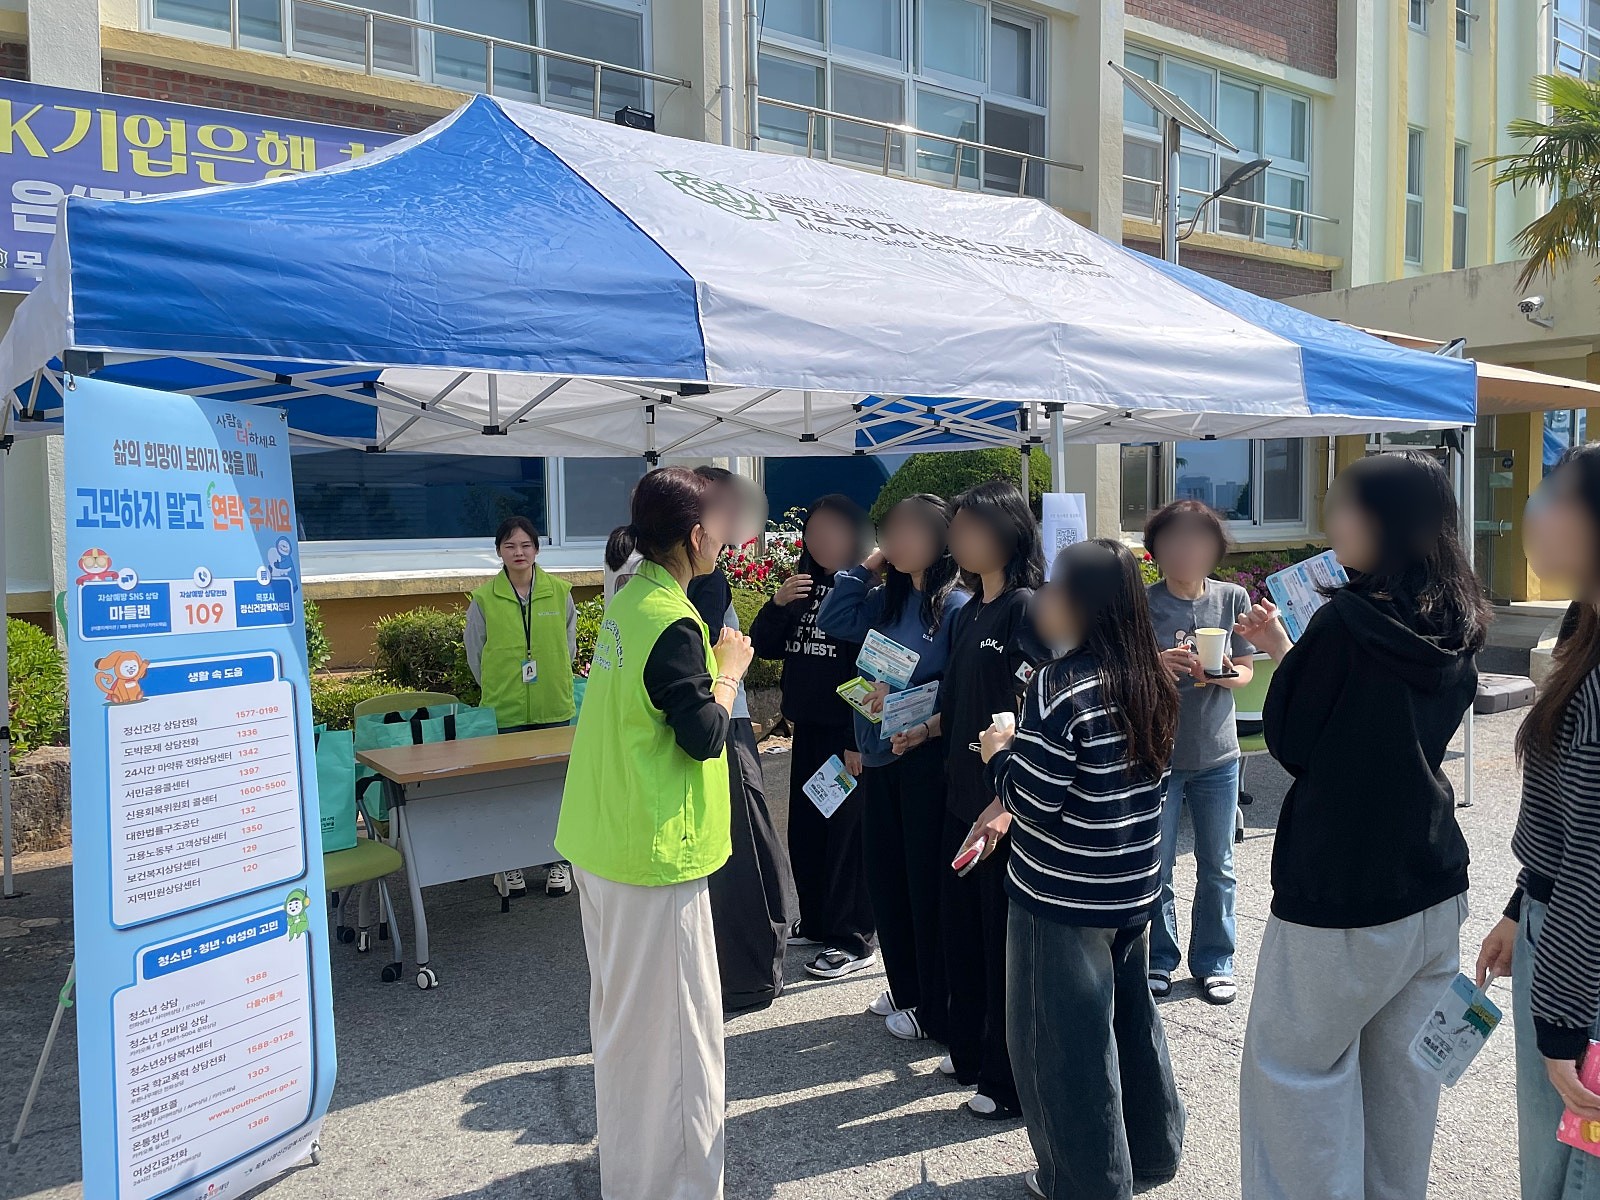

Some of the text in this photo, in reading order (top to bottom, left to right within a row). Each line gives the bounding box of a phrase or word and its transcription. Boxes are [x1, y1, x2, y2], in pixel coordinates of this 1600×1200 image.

[764, 197, 1103, 268] 목포여자상업고등학교
[795, 219, 868, 241] Mokpo
[113, 439, 264, 478] 삶의 희망이 보이지 않을 때,
[76, 488, 292, 532] 고민하지 말고 연락 주세요
[97, 592, 159, 602] 자살예방 SNS 상담
[256, 593, 275, 602] 목포시
[109, 604, 151, 620] 마들랜
[185, 602, 224, 625] 109
[803, 642, 837, 658] WEST.
[187, 667, 243, 683] 생활 속 도움
[236, 706, 279, 719] 1577-0199
[123, 717, 198, 736] 정신건강 상담전화
[237, 728, 258, 738] 1336
[124, 737, 200, 757] 도박문제 상담전화
[238, 747, 259, 757] 1342
[124, 751, 232, 778] 24시간 마약류 전화상담센터
[239, 766, 260, 777] 1397
[125, 780, 190, 799] 서민금융콜센터
[240, 779, 286, 796] 1600-5500
[125, 794, 218, 821] 신용회복위원회 콜센터
[240, 806, 256, 815] 132
[126, 818, 200, 841] 대한법률구조공단
[241, 823, 263, 834] 1350
[126, 832, 227, 862] 고용노동부 고객상담센터
[242, 844, 257, 854] 129
[126, 858, 200, 884] 보건복지상담센터
[242, 863, 258, 873] 120
[127, 878, 201, 904] 지역민원상담센터
[258, 920, 279, 935] 고민
[245, 971, 267, 985] 1388
[129, 998, 178, 1021] 청소년 상담
[246, 990, 283, 1010] 다들어줄개
[129, 1014, 208, 1049] 청소년 모바일 상담
[247, 1031, 294, 1055] 1588-9128
[130, 1039, 213, 1076] 청소년상담복지센터
[130, 1053, 226, 1097] 전국 학교폭력 상담전화
[247, 1065, 270, 1080] 1303
[208, 1078, 298, 1122] www.youthcenter.go.kr
[131, 1099, 178, 1123] 국방헬프콜
[247, 1115, 270, 1129] 1366
[132, 1129, 169, 1152] 온통청년
[133, 1148, 188, 1177] 여성긴급전화
